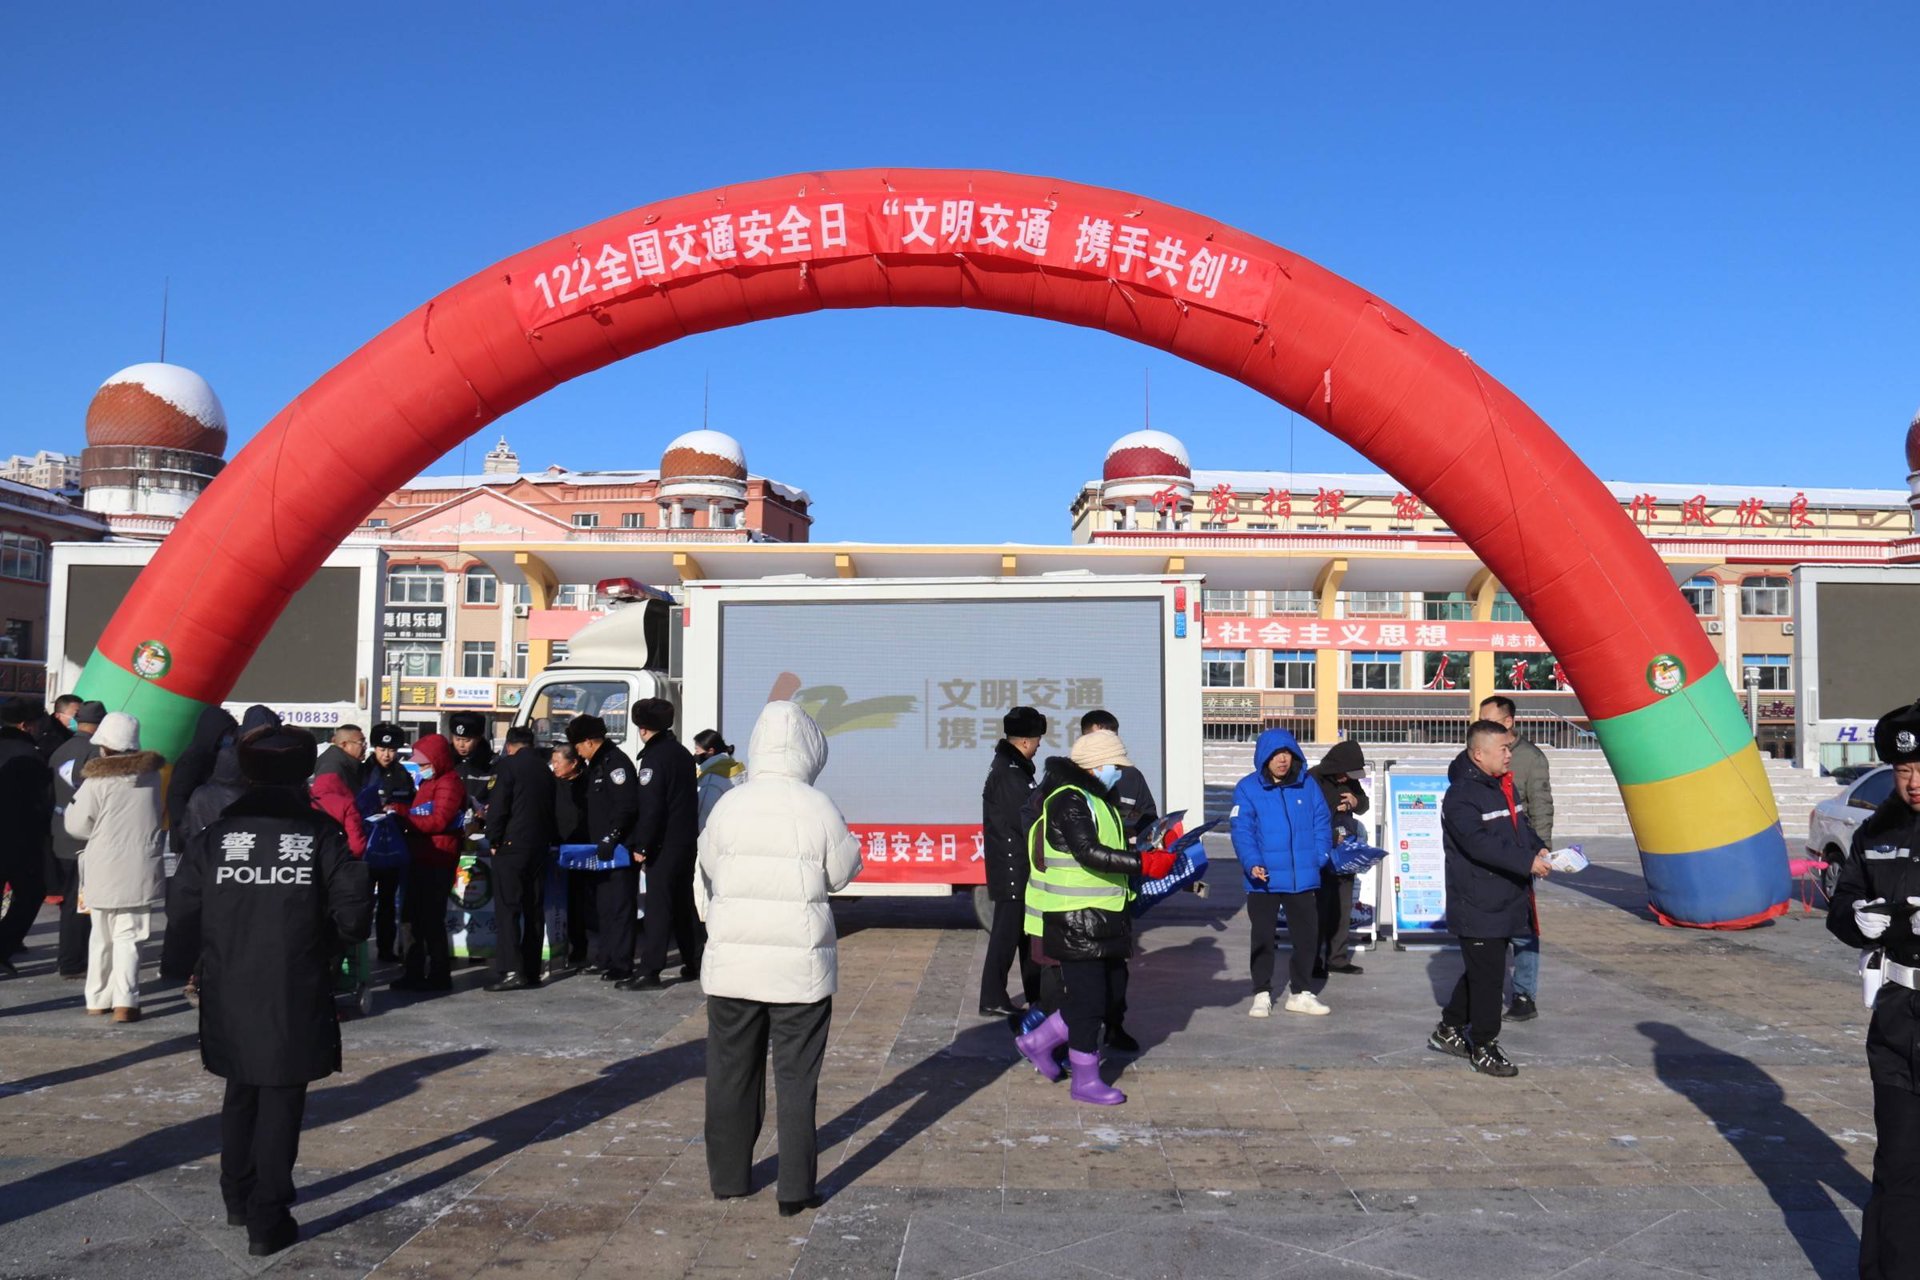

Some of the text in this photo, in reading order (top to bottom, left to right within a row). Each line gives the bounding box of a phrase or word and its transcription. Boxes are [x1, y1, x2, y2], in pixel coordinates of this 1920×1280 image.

[534, 197, 1248, 309] 122全国交通安全日 “文明交通 携手共创”
[1151, 484, 1345, 523] 听党指挥
[1630, 492, 1815, 530] 作风优良
[937, 678, 1104, 710] 文明交通
[220, 831, 314, 862] 警察
[216, 866, 313, 885] POLICE
